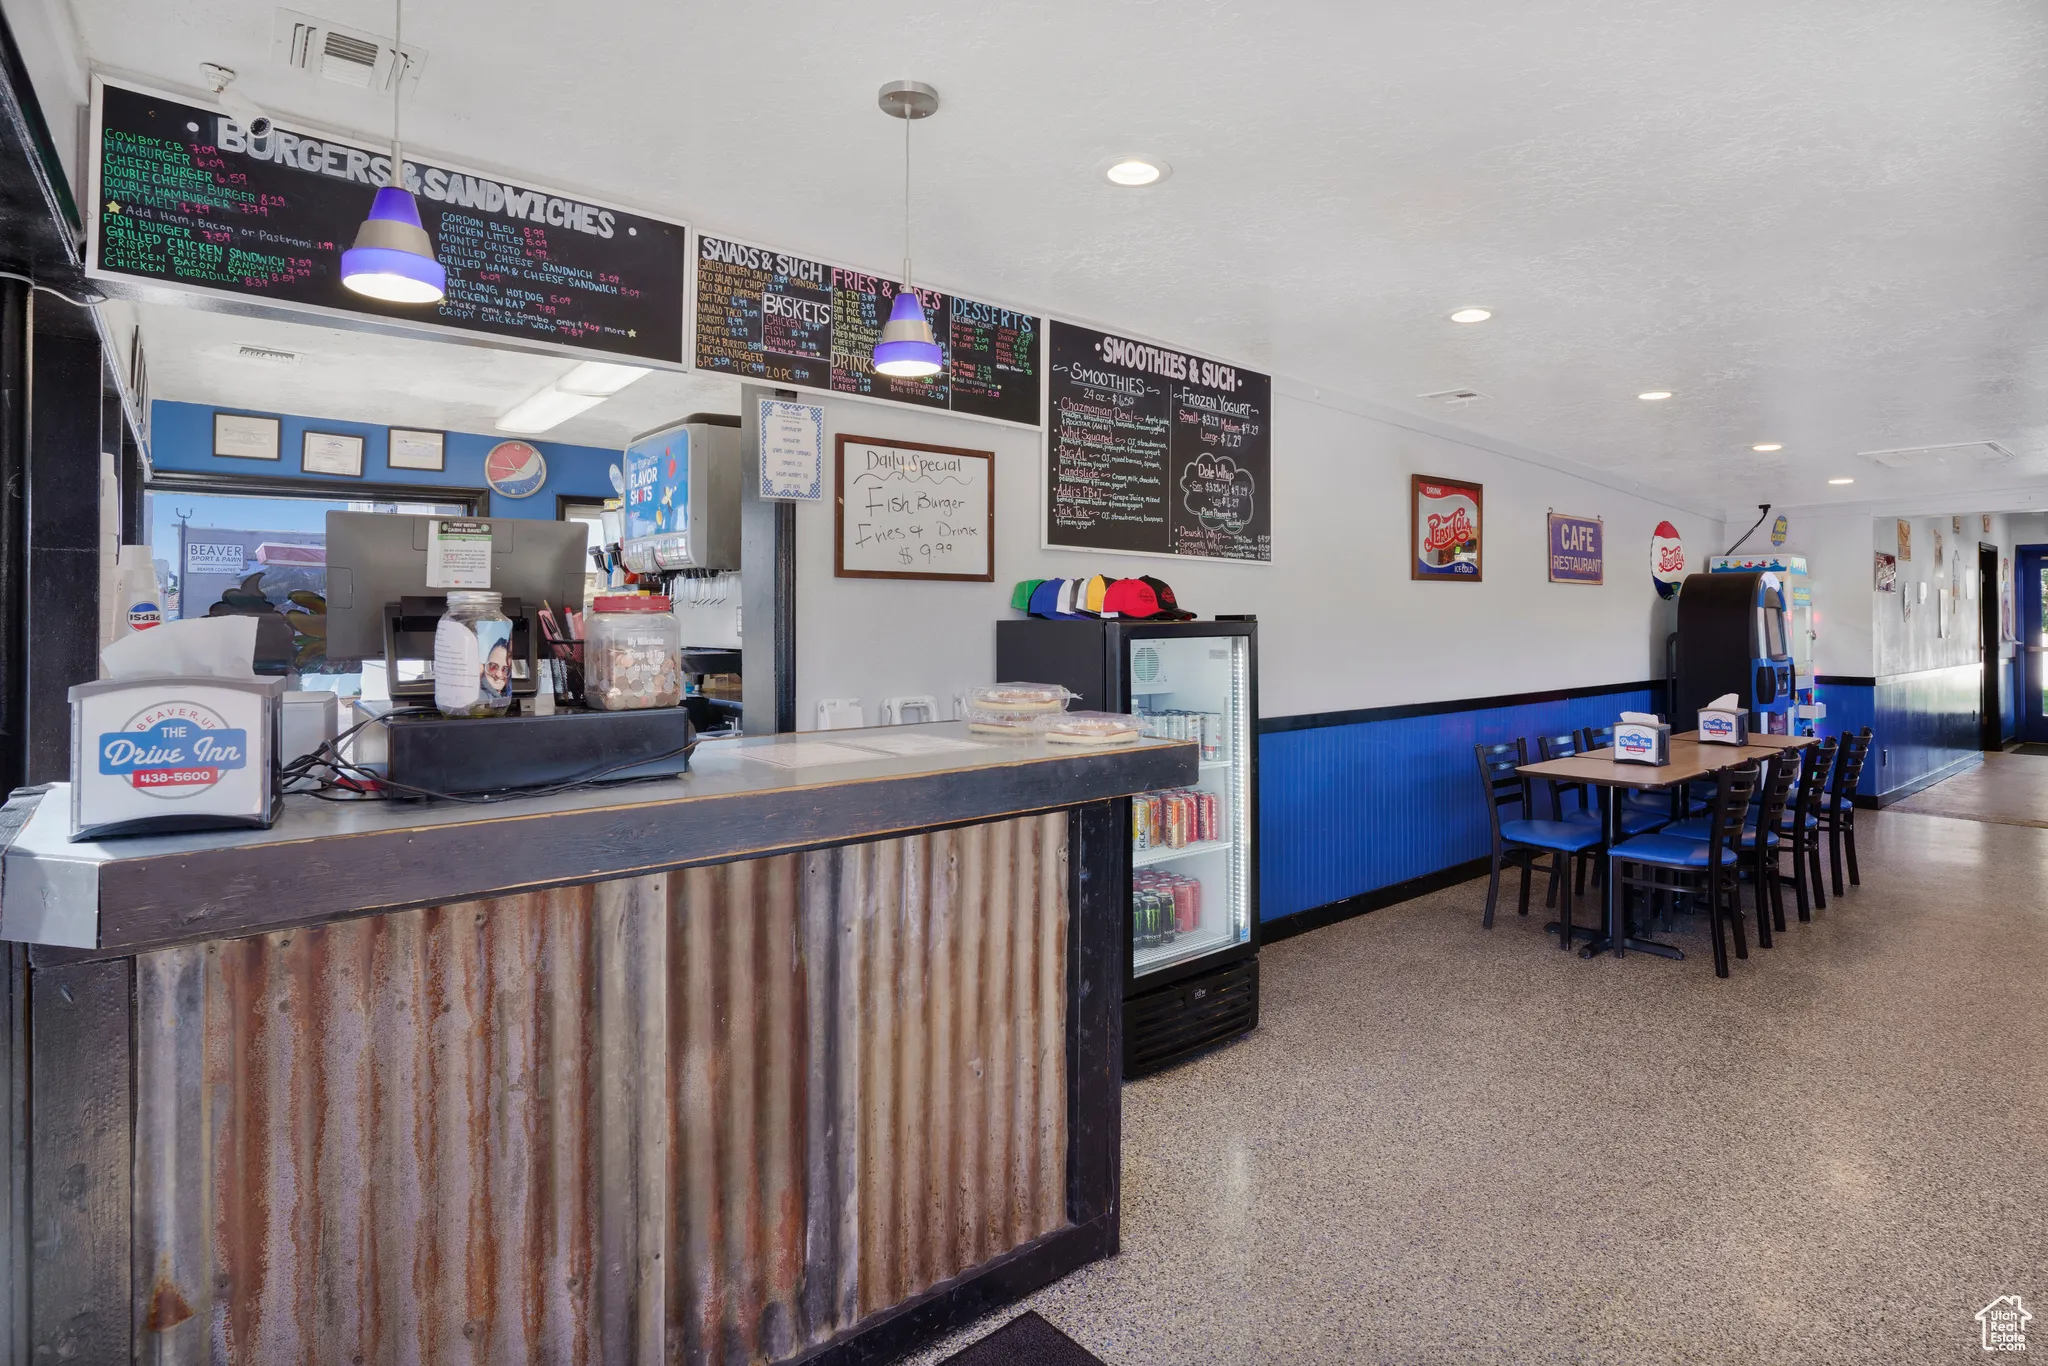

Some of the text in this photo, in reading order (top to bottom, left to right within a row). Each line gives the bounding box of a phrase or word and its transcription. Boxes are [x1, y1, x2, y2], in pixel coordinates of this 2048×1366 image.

[106, 129, 183, 152] COWBOY CB
[104, 140, 190, 166] HAMBURGER
[106, 154, 247, 185] CHEESE BURGER 6.59
[217, 117, 616, 239] BURGERS SANDWICHES
[104, 165, 285, 206] DOUBLE CHEESE BURGER 8.29
[104, 177, 230, 208] DOUBLE HAMBURGER
[104, 189, 178, 211] PATTY MELT
[104, 214, 191, 238] FISH BURGER
[126, 206, 254, 236] Add Bacon or
[442, 212, 515, 234] CORDON BLEU
[439, 234, 520, 255] MONTE CRISTO
[441, 223, 524, 245] CHICKEN LITTLES
[106, 226, 285, 267] GRILLED CHICKEN SANDWICH
[107, 238, 283, 273] CRISPY CHICKEN SANDWICH
[106, 248, 268, 280] CHICKEN BACON RANCH
[106, 258, 239, 283] CHICKEN QUESADILLA
[441, 244, 592, 279] GRILLED CHEESE SANDWICH
[699, 258, 772, 282] GRILLED CHICKEN SALAD
[762, 252, 772, 271] &
[776, 255, 822, 282] SUCH
[439, 255, 617, 294] GRILLED HAM & CHEESE SANDWICH
[698, 271, 766, 291] TACO SALAD CHIPS
[833, 268, 892, 298] FRIES &
[470, 282, 498, 296] LONG
[698, 281, 762, 300] TACO SALAD SUPREME
[847, 291, 860, 300] FRY
[494, 297, 526, 309] WRAP
[725, 307, 741, 317] TACO
[764, 295, 830, 324] BASKETS
[439, 308, 556, 333] CRISPY CHICKEN WRAP
[450, 300, 625, 335] Make any only more
[698, 314, 725, 325] BURRITO
[766, 315, 801, 329] CHICKEN
[953, 297, 1032, 332] DESSERTS
[765, 325, 784, 336] FISH
[765, 336, 796, 347] SHRIMP
[697, 343, 727, 356] CHICKEN
[729, 349, 764, 362] NUGGETS
[723, 339, 747, 349] BURRITO
[834, 338, 855, 348] CHEESE
[832, 353, 877, 374] DRINKS
[1103, 337, 1235, 392] SMOOTHIES & SUCH
[833, 376, 856, 384] MEDIUM
[1071, 362, 1145, 395] SMOOTHIES
[1083, 388, 1094, 399] 24
[1183, 386, 1251, 415] FROZEN YOGURT
[1061, 397, 1133, 420] Chazmanian Devil
[1060, 425, 1112, 443] Whit Squared
[867, 451, 961, 480] Daily Special
[1059, 465, 1099, 478] Landslide
[1199, 464, 1234, 485] Dole Whip
[631, 467, 657, 488] FLAVOR
[866, 487, 965, 517] Fish Burger
[1427, 487, 1441, 495] DRINK
[856, 524, 905, 548] Fries
[936, 521, 978, 537] Drink
[1561, 524, 1594, 552] CAFE
[191, 545, 241, 556] BEAVER
[898, 543, 952, 565] $ 9.99
[1553, 556, 1601, 573] RESTAURANT
[628, 637, 664, 647] My Milkshake
[137, 708, 216, 730] BEAVER, UT
[161, 727, 187, 738] THE
[1640, 739, 1651, 747] Inn
[105, 737, 241, 766] Drive Inn
[140, 772, 210, 783] 438-5600
